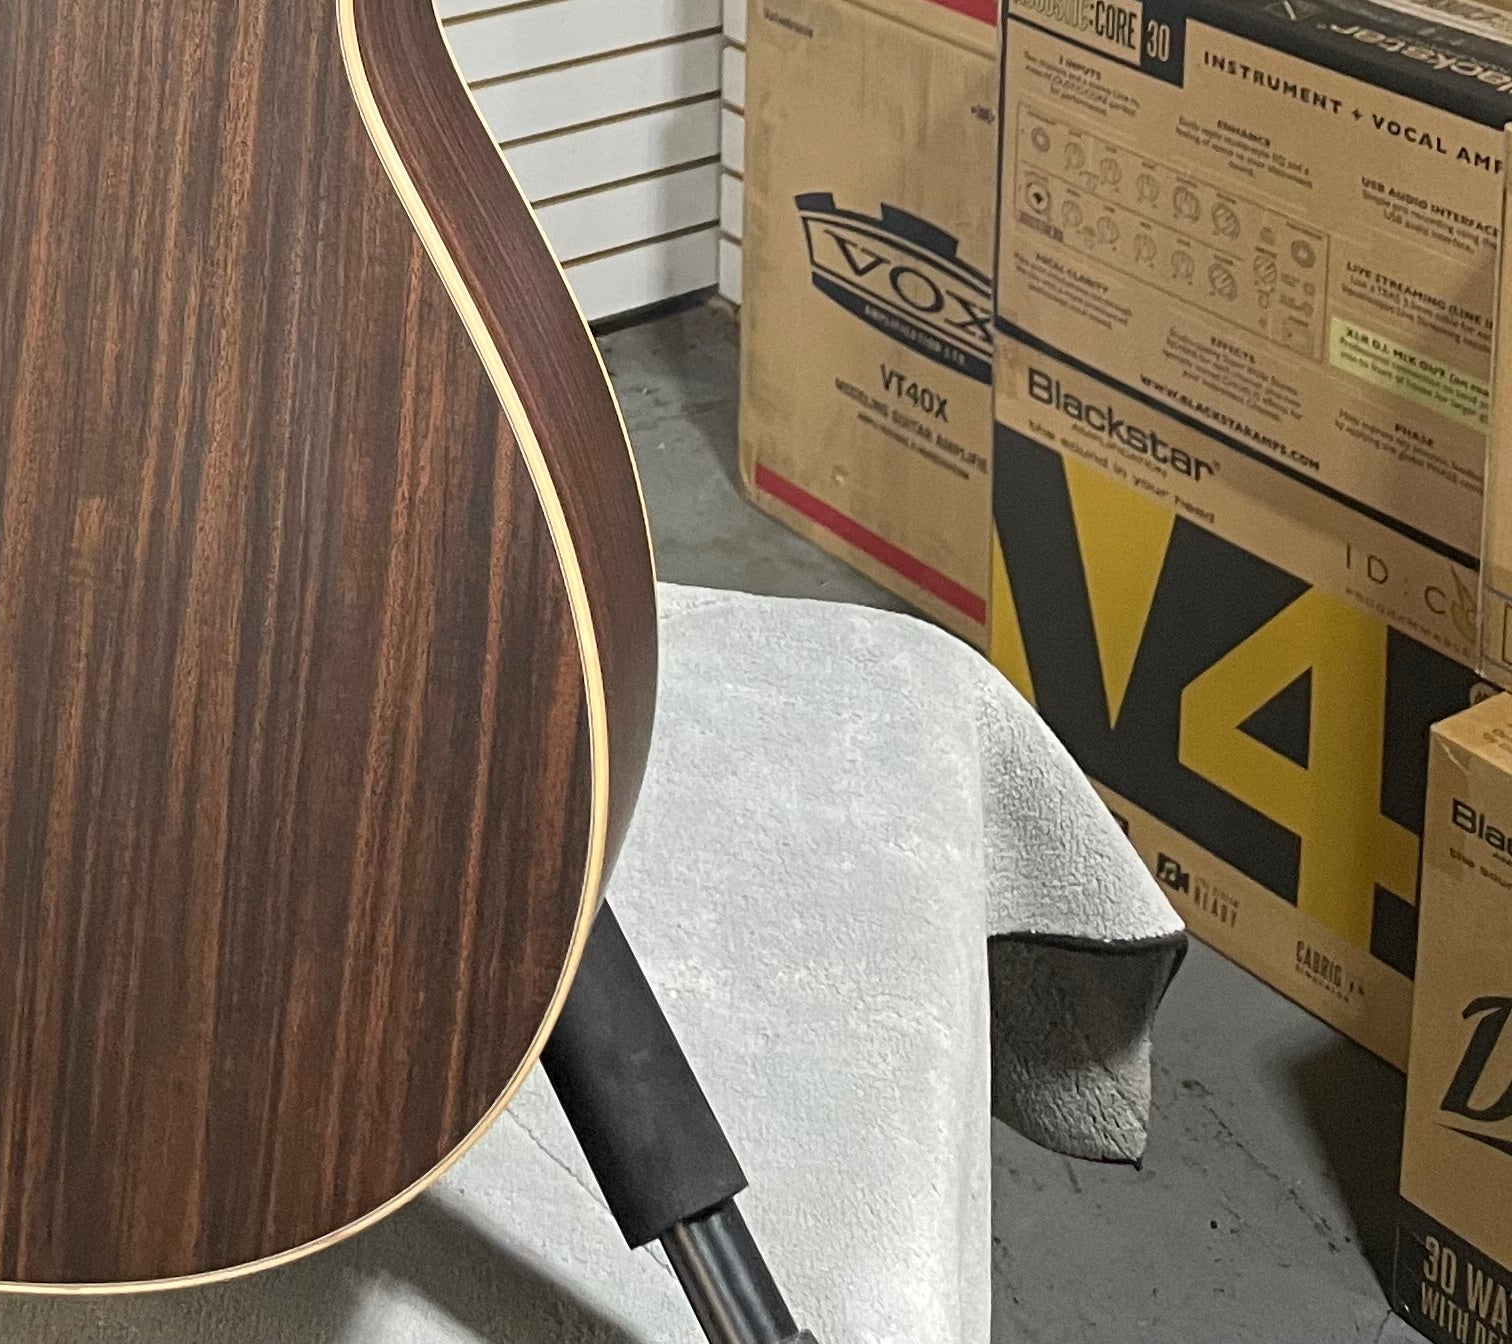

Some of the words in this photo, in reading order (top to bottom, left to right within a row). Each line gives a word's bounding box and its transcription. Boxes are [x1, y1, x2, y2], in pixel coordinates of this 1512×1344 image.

[1146, 18, 1171, 62] 30
[1203, 50, 1343, 115] INSTRUMENT
[1372, 112, 1447, 155] VOCAL
[1388, 186, 1429, 210] AUDIO
[823, 227, 993, 345] VOX
[879, 362, 949, 424] VT40X
[1027, 366, 1216, 483] Blackstar
[1060, 437, 1109, 469] sound
[1112, 462, 1128, 479] in
[1132, 474, 1171, 499] your
[1421, 1280, 1470, 1344] WITH
[1423, 1234, 1457, 1295] 30
[1466, 1262, 1512, 1336] WA
